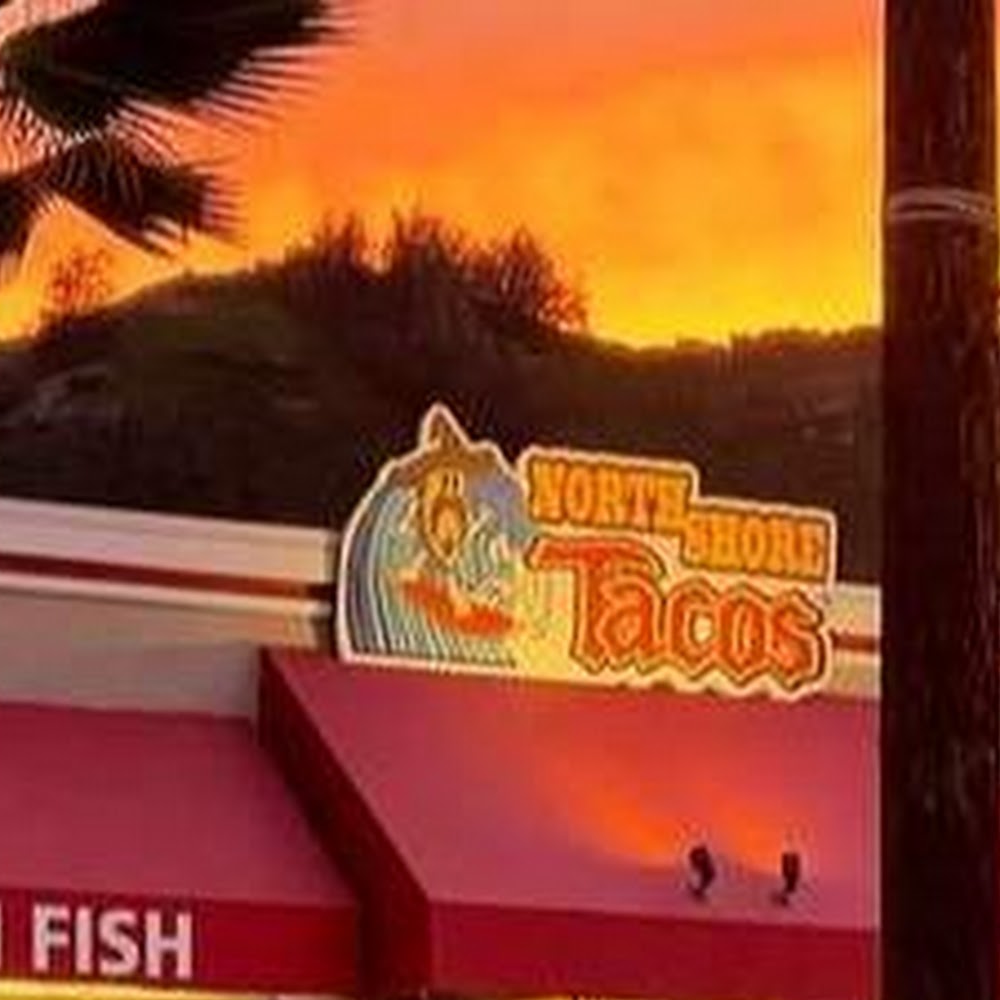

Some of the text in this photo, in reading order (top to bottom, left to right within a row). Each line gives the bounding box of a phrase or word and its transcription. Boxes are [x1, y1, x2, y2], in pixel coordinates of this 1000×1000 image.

[529, 457, 829, 583] NORTH SHORE
[525, 534, 826, 691] Tacos
[32, 903, 192, 979] FISH
